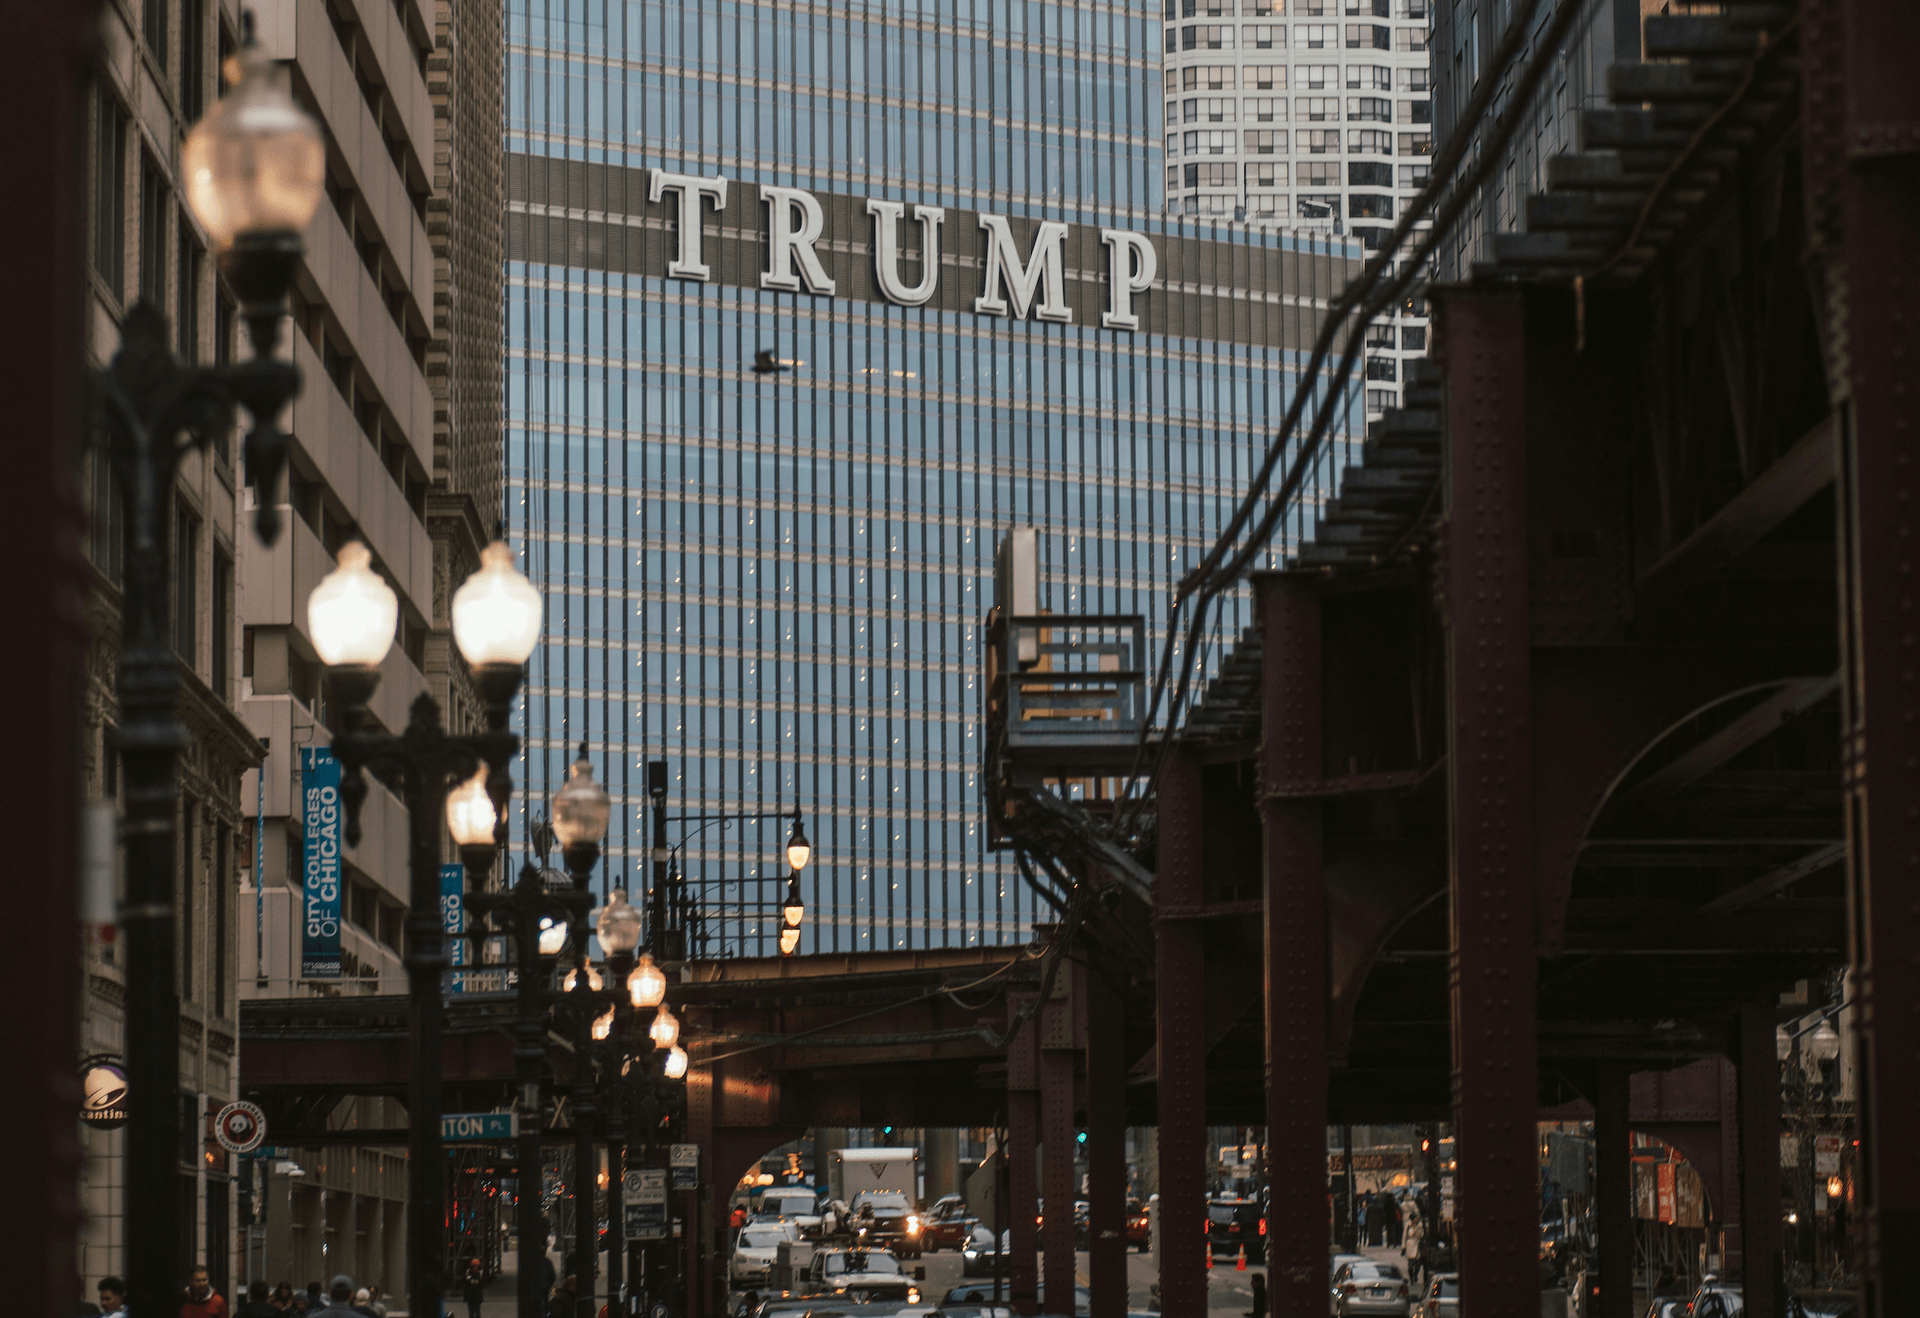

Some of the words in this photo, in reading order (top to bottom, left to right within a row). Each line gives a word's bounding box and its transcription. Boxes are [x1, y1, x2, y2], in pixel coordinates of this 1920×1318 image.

[649, 167, 1157, 331] TRUMP
[307, 787, 321, 889] COLLEGES
[320, 786, 338, 902] CHICAGO
[307, 894, 321, 938] CITY
[321, 909, 338, 938] OF
